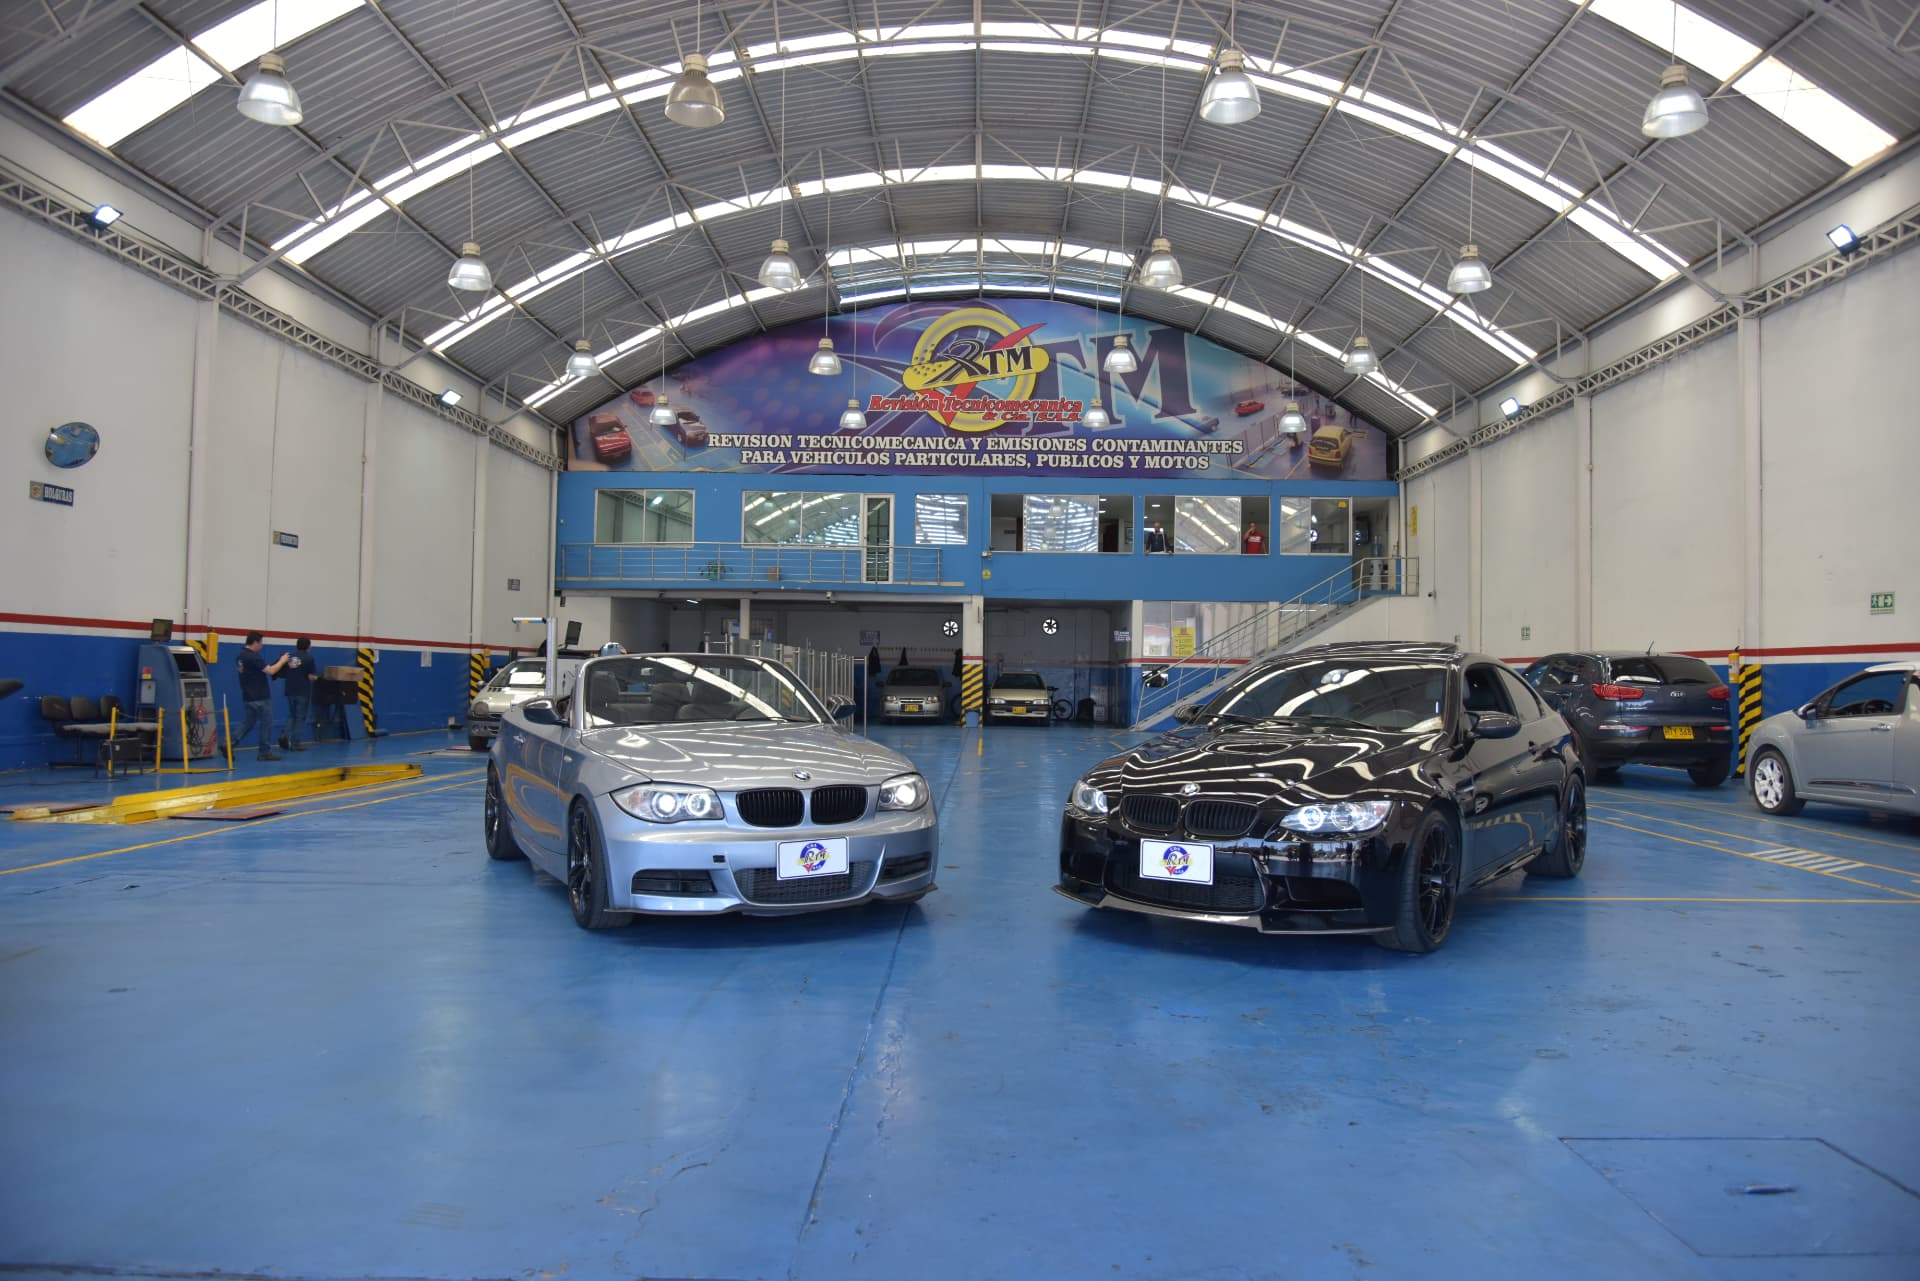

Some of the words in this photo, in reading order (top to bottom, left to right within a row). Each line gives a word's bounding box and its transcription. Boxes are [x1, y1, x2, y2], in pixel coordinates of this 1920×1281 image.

[923, 338, 1034, 386] RTM
[867, 394, 940, 412] Revisión
[942, 395, 1084, 413] Tecnicomecanica
[981, 411, 996, 421] &
[707, 434, 792, 448] REVISION
[797, 435, 965, 450] TECNICOMECANICA
[970, 437, 983, 450] Y
[987, 437, 1087, 451] EMISIONES
[1092, 438, 1244, 454] CONTAMINANTES
[741, 450, 786, 464] PARA
[790, 451, 890, 465] VEHICULOS
[894, 452, 1031, 469] PARTICULARES,
[1036, 454, 1124, 468] PUBLICOS
[1128, 455, 1141, 468] Y
[1144, 455, 1209, 469] MOTOS
